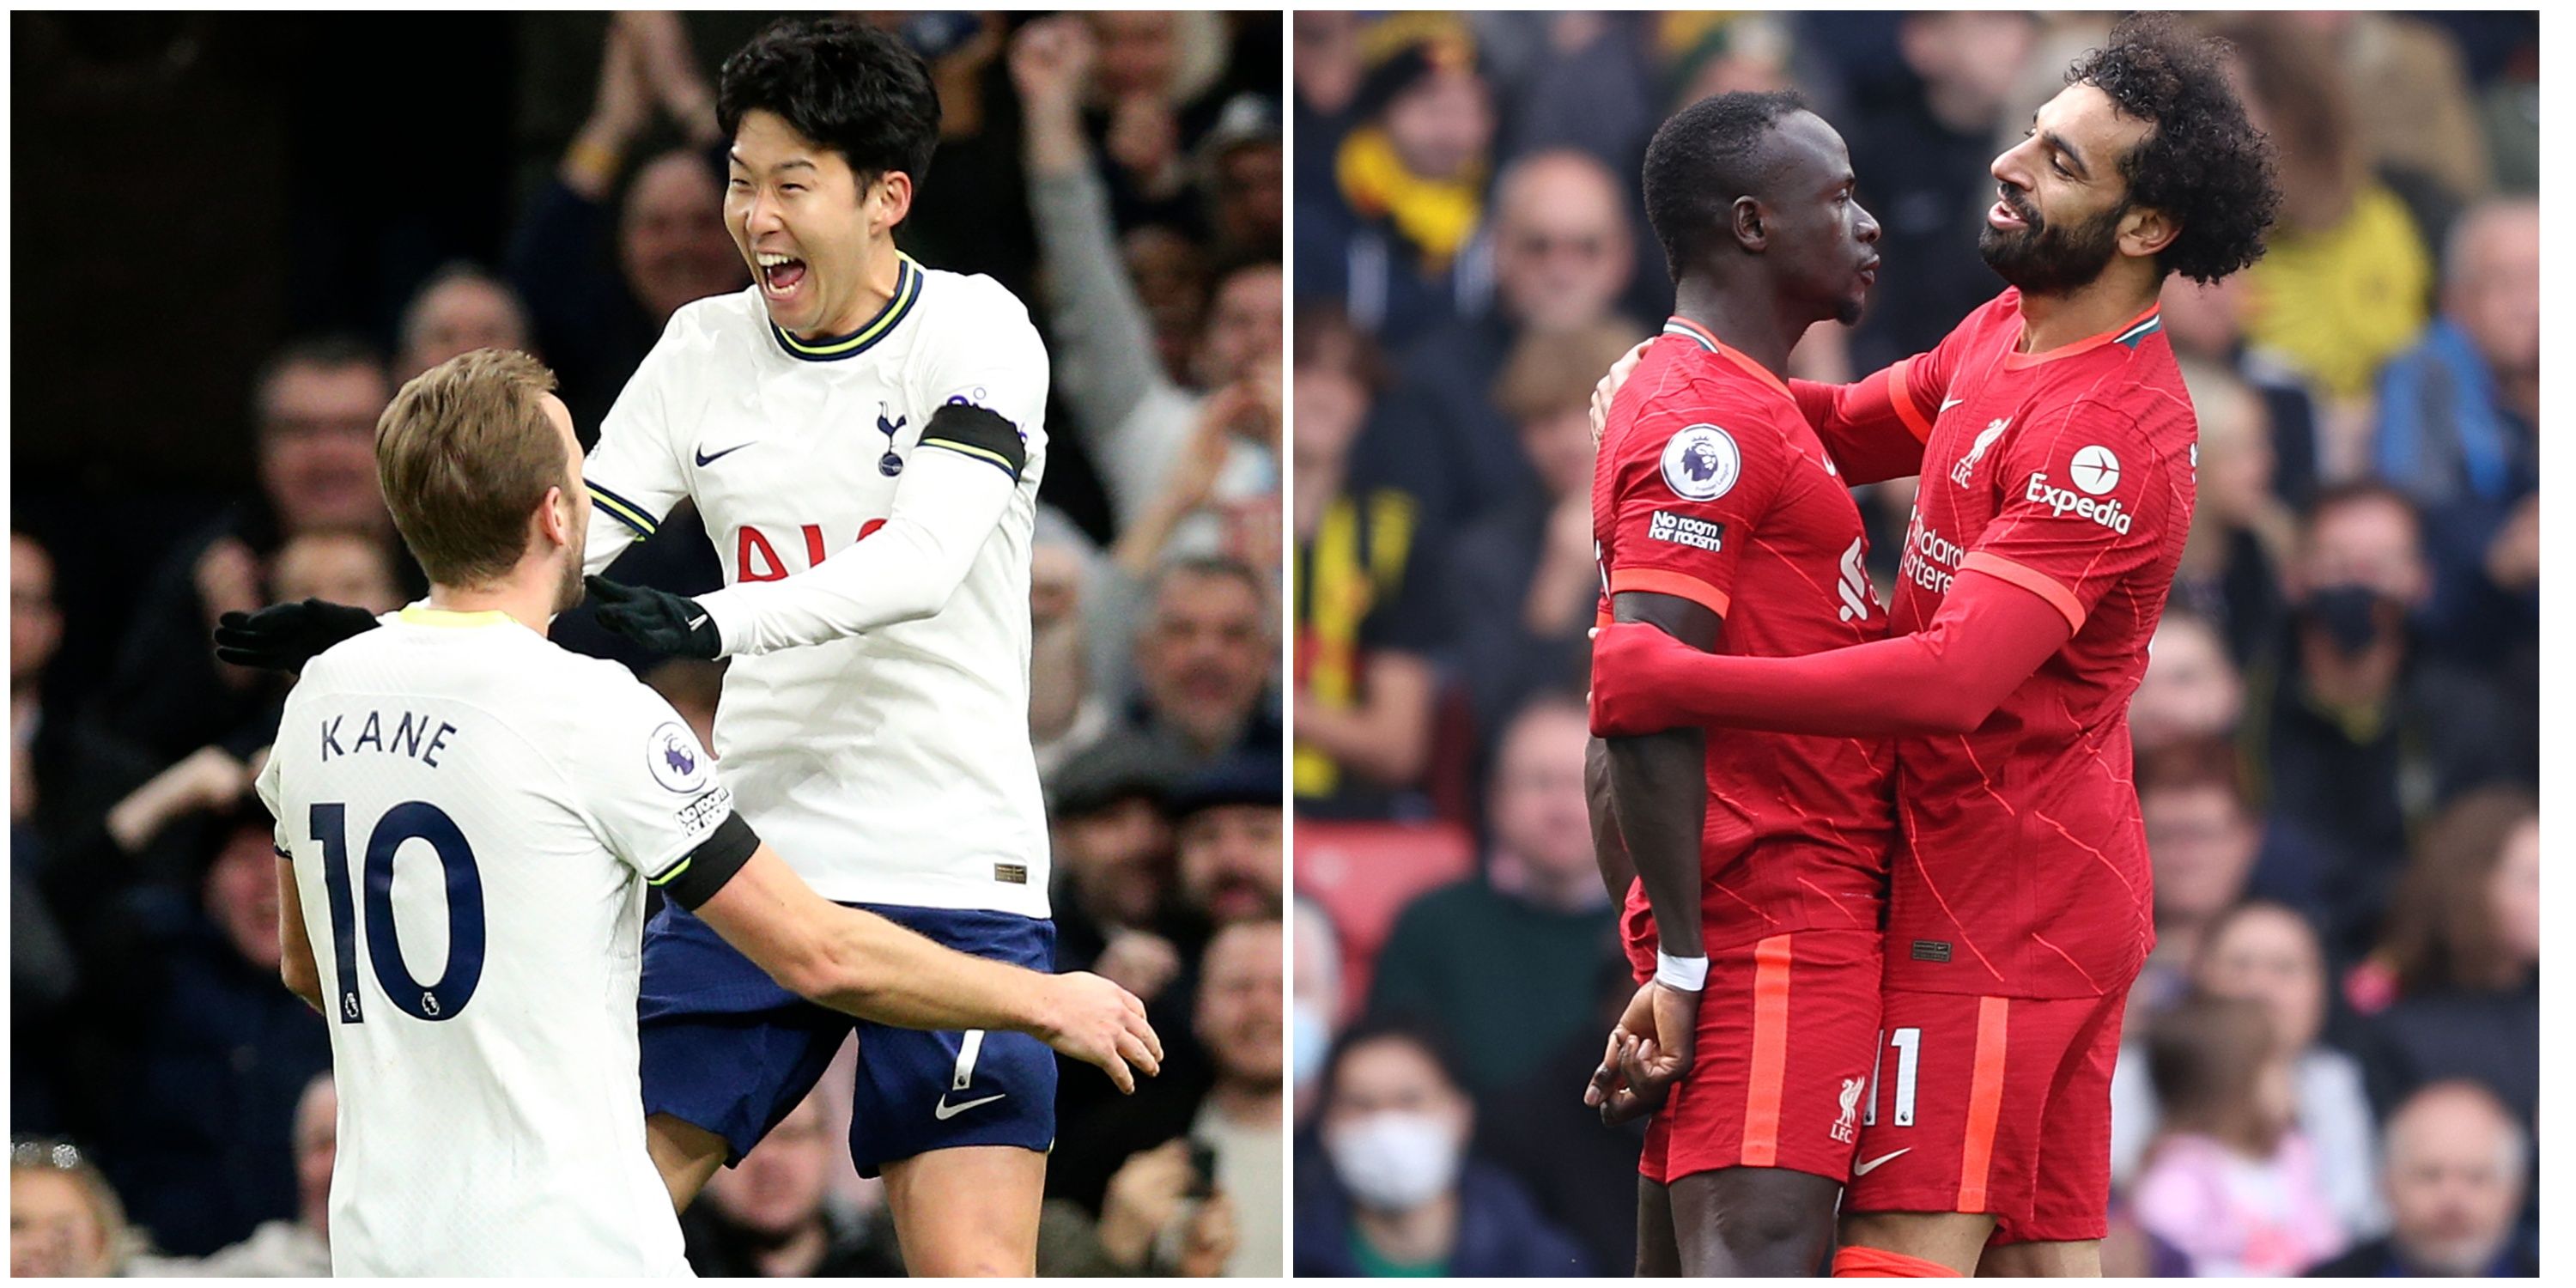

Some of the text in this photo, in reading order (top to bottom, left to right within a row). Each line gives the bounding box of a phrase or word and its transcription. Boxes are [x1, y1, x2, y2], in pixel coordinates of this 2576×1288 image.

[1651, 510, 1718, 538] No room
[2026, 472, 2132, 536] Expedia
[321, 711, 457, 769] KANE
[309, 800, 486, 1024] 10
